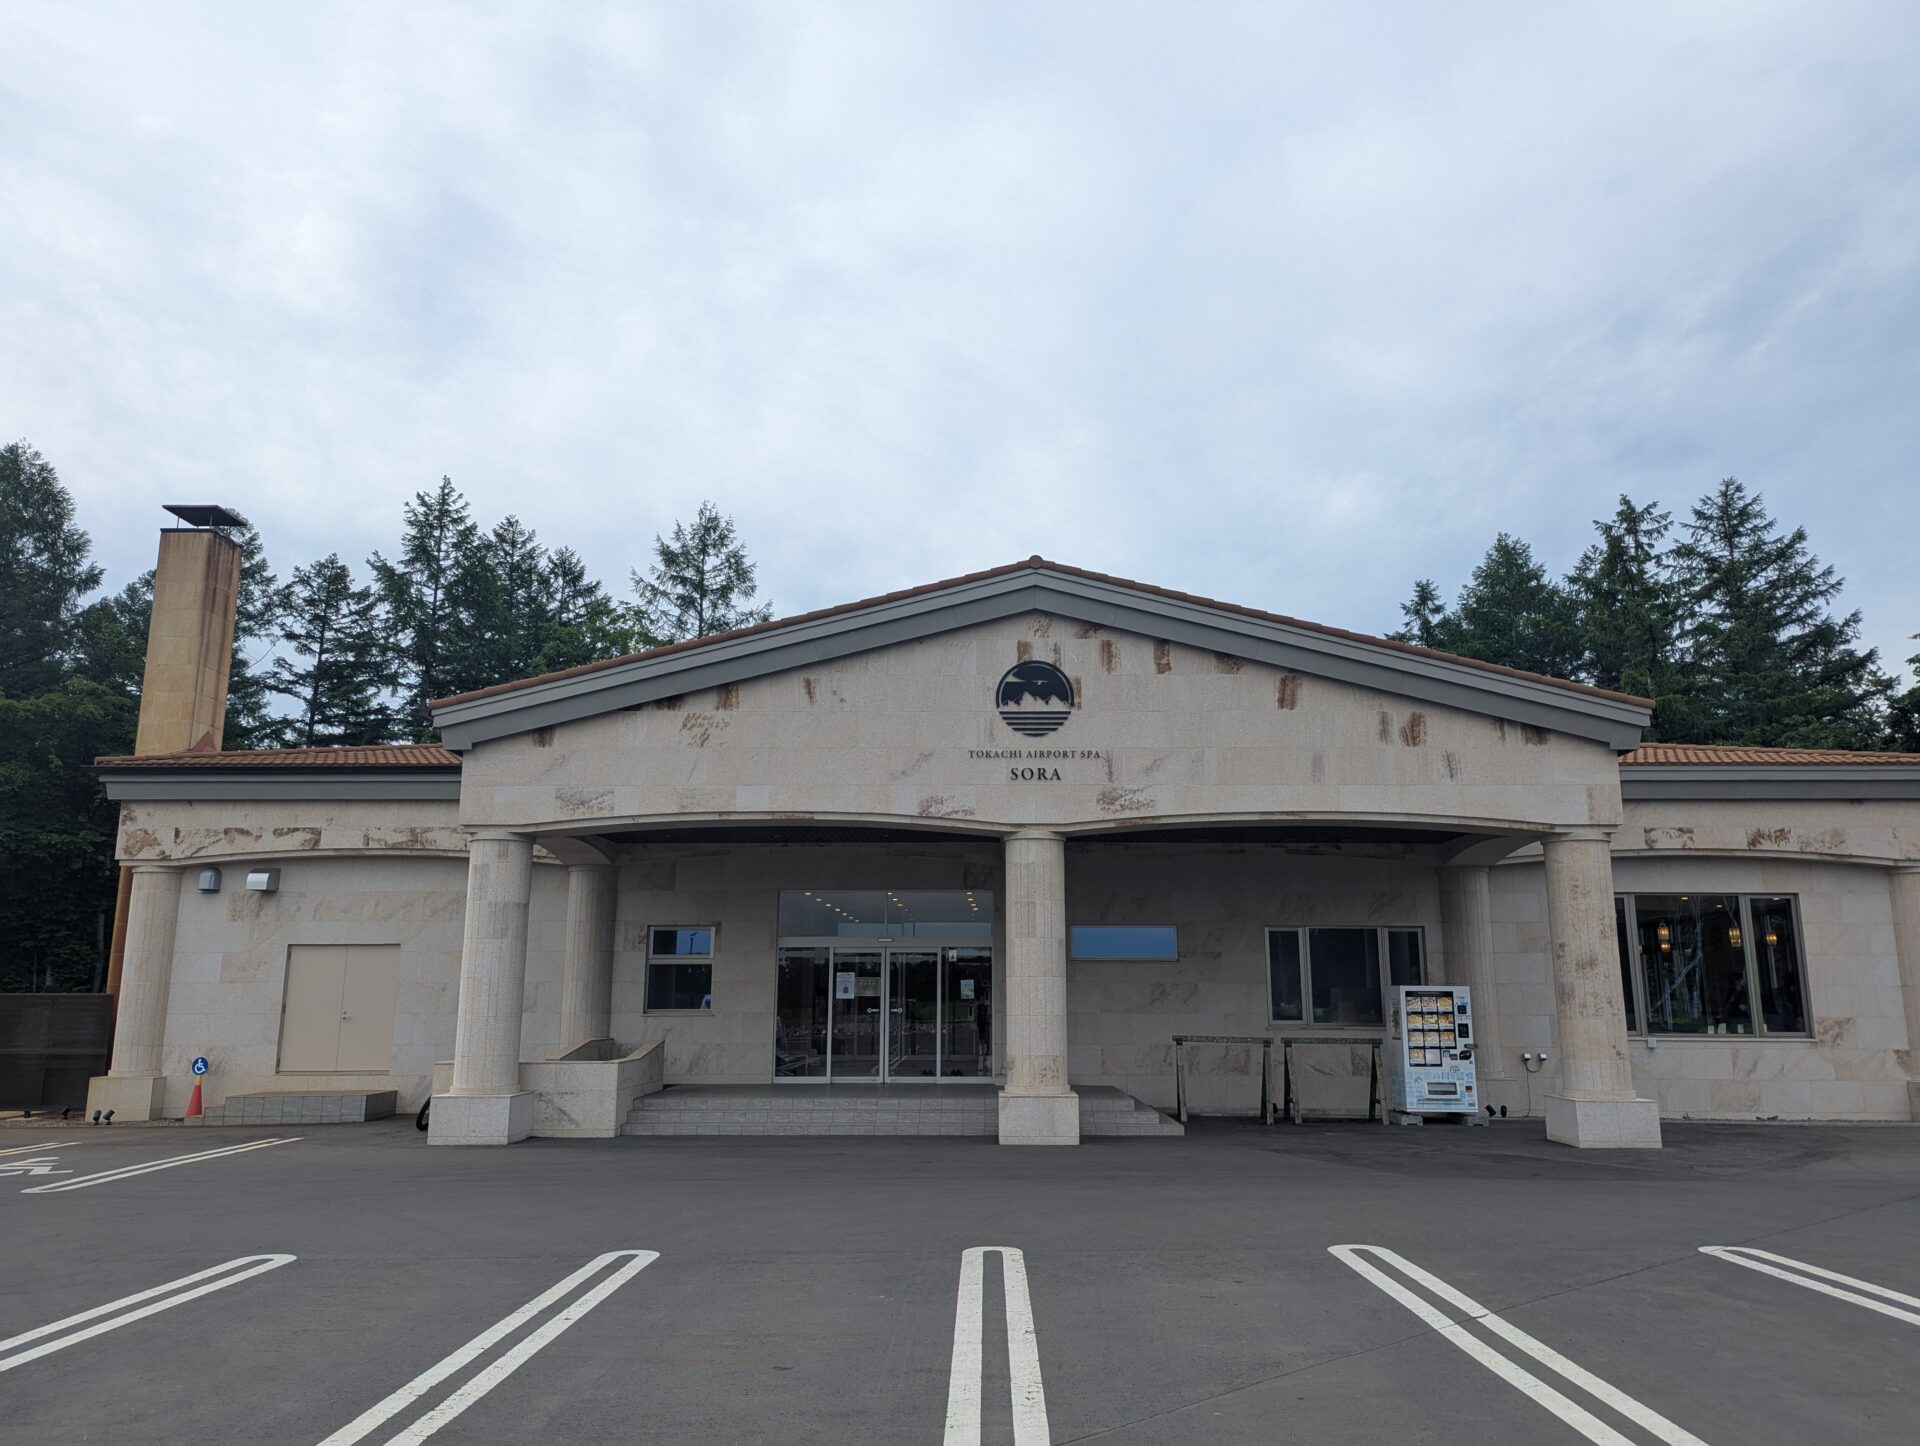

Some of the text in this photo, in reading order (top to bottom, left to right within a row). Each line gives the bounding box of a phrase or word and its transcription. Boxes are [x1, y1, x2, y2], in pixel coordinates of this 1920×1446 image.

[968, 750, 1101, 759] TOKACHI AIRPORT SPA
[1010, 767, 1062, 780] SORA
